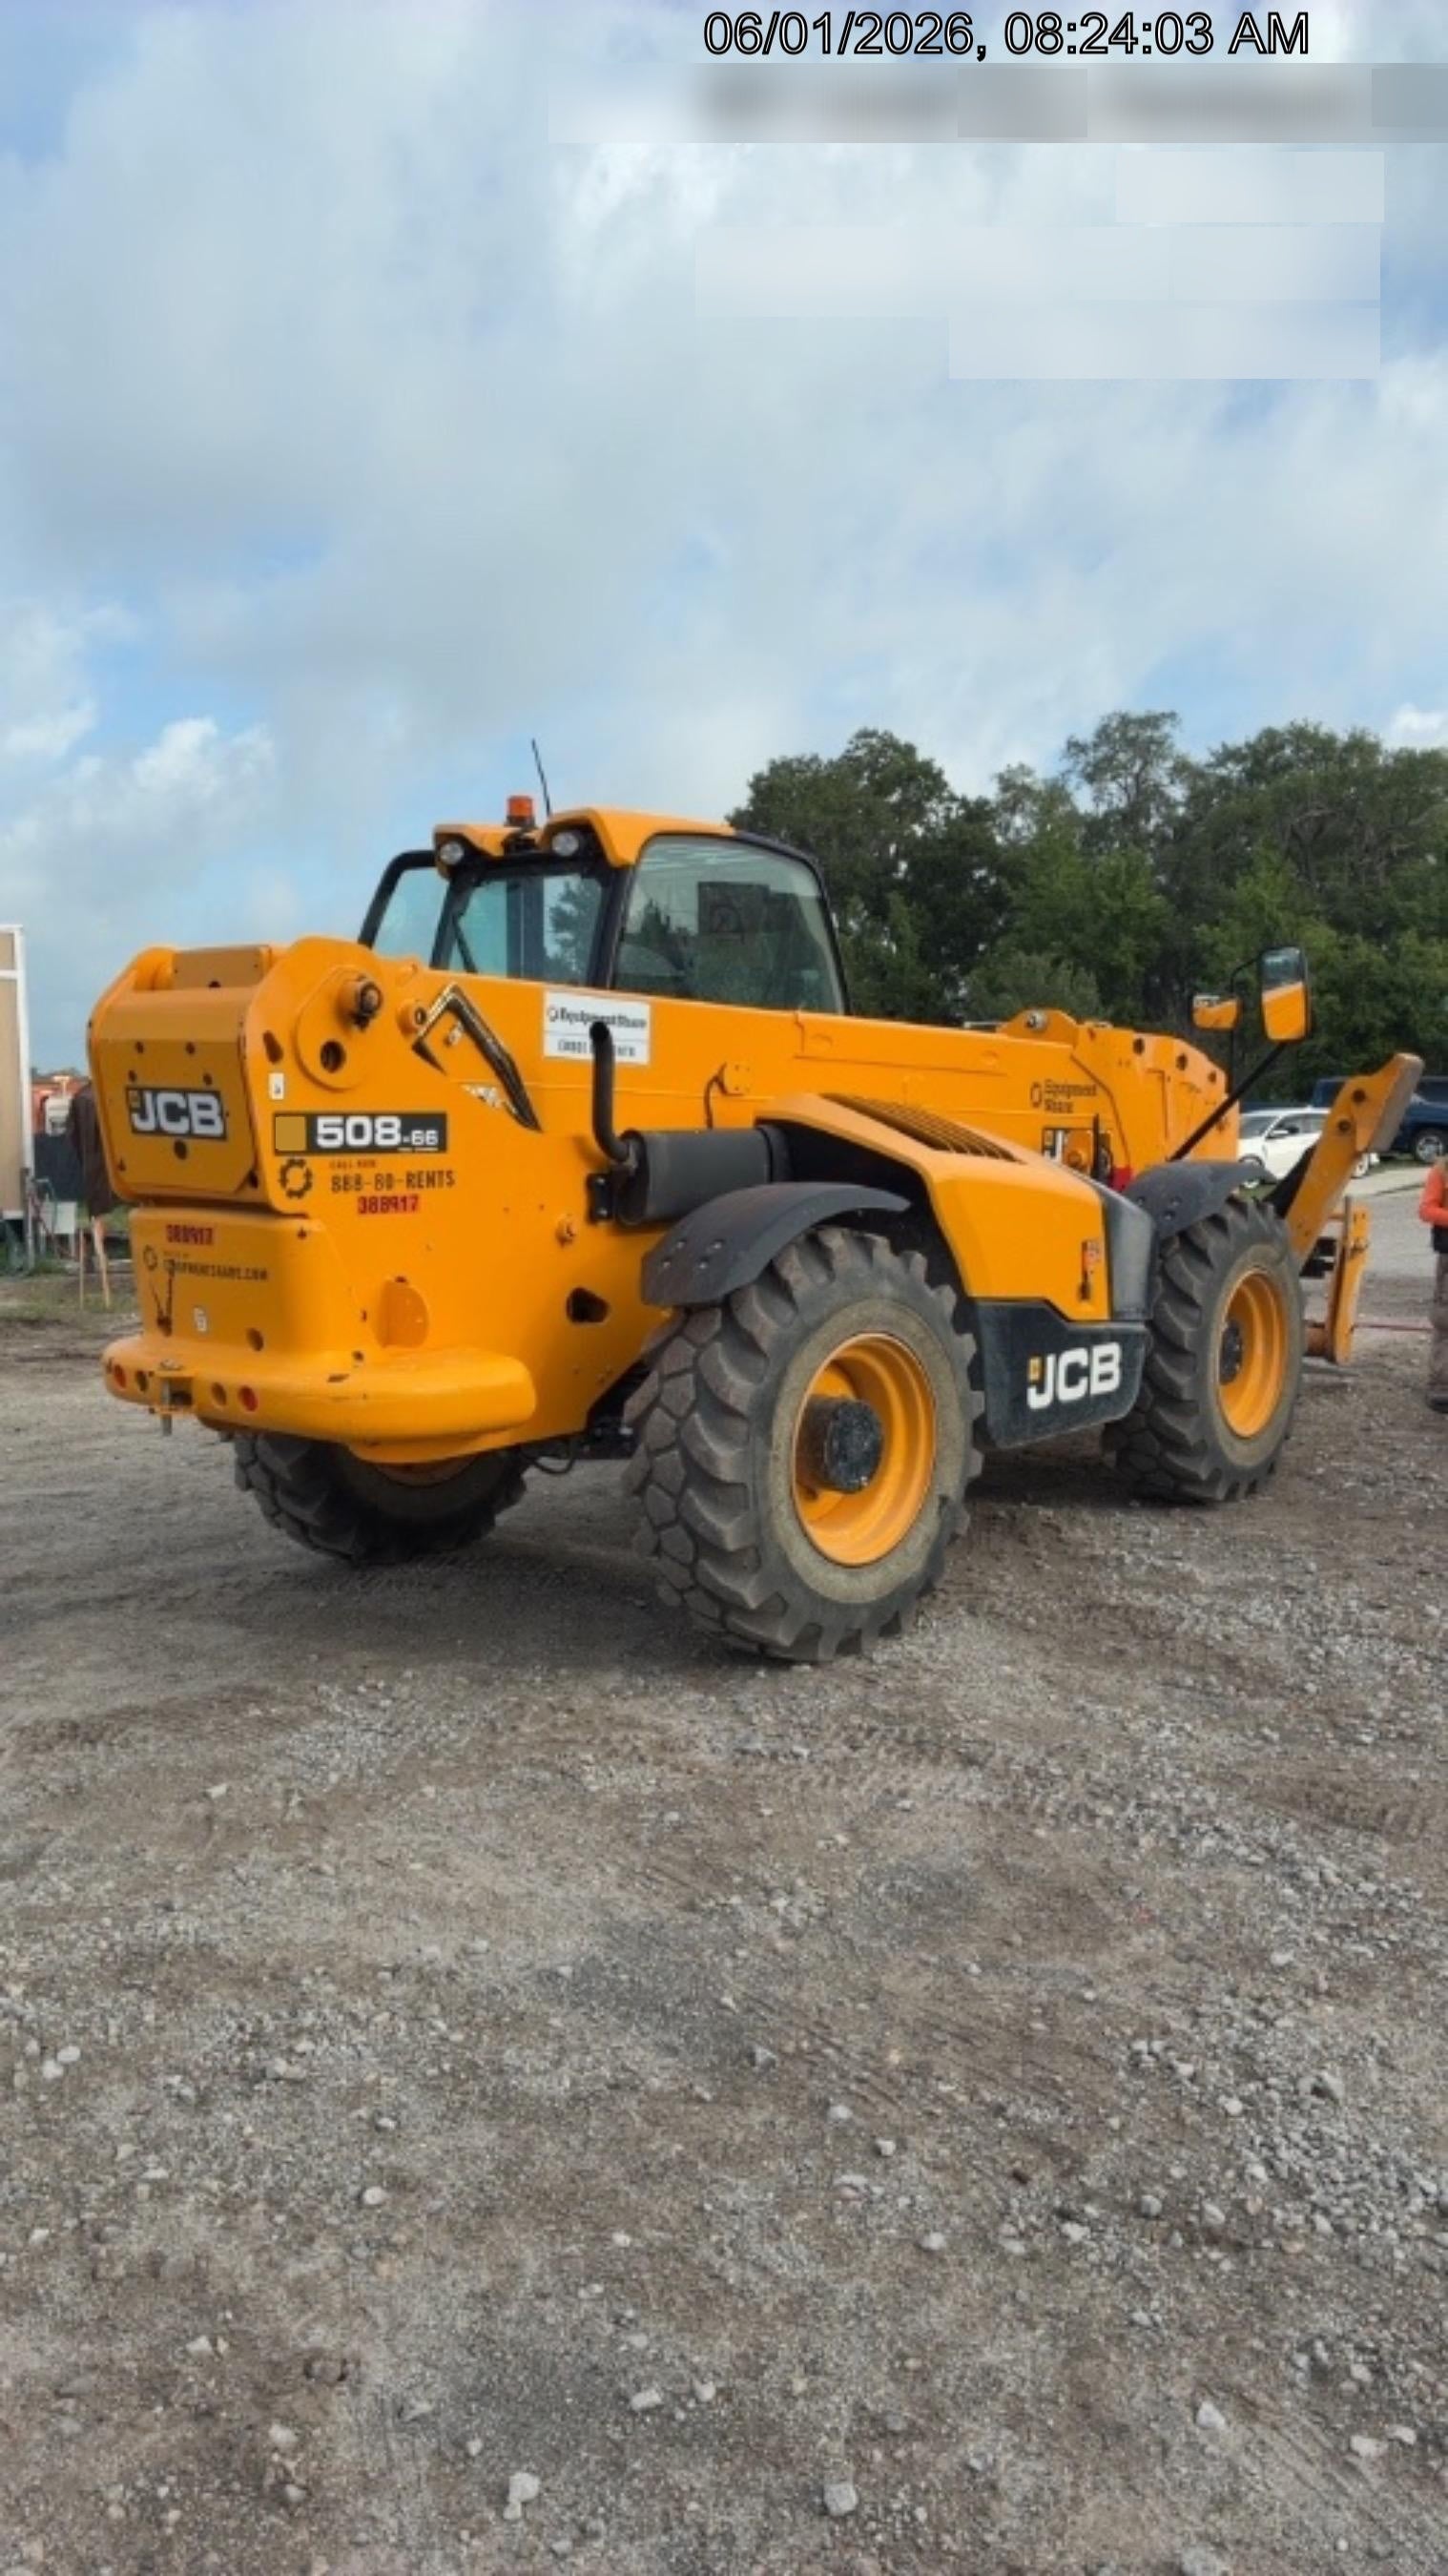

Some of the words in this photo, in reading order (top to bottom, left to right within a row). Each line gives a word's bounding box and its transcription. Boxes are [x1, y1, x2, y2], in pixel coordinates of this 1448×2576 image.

[131, 1090, 225, 1137] JCB
[316, 1114, 440, 1149] 508-66
[331, 1170, 456, 1194] 888-80-RENTS
[357, 1195, 420, 1215] 388917
[1026, 1342, 1121, 1410] JCB
